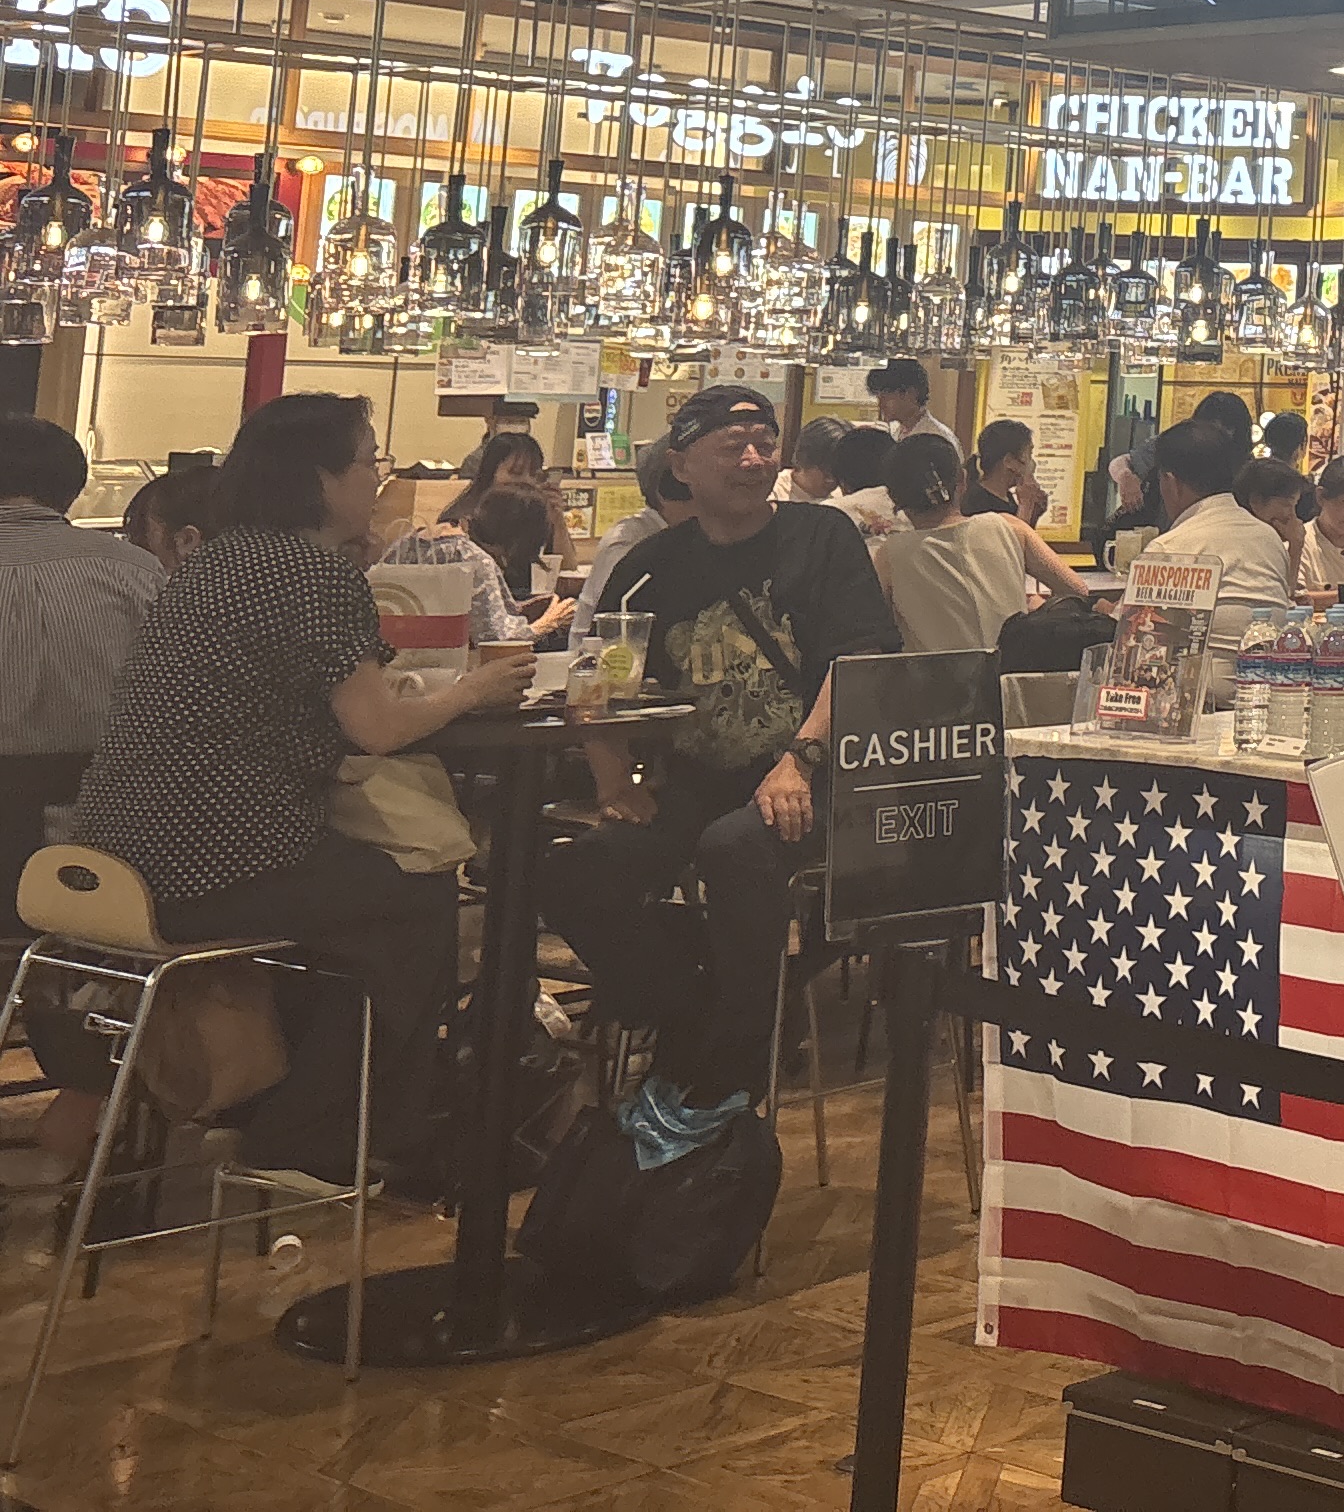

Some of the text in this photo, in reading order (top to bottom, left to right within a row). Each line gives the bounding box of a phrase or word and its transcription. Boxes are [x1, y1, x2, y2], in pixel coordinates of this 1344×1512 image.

[1047, 94, 1296, 150] CHICKEN
[1042, 148, 1294, 205] NAN-BAR
[1131, 564, 1213, 591] TRANSPORTER
[1105, 690, 1142, 705] Take Free
[839, 722, 997, 770] CASHIER
[875, 799, 960, 844] EXIT
